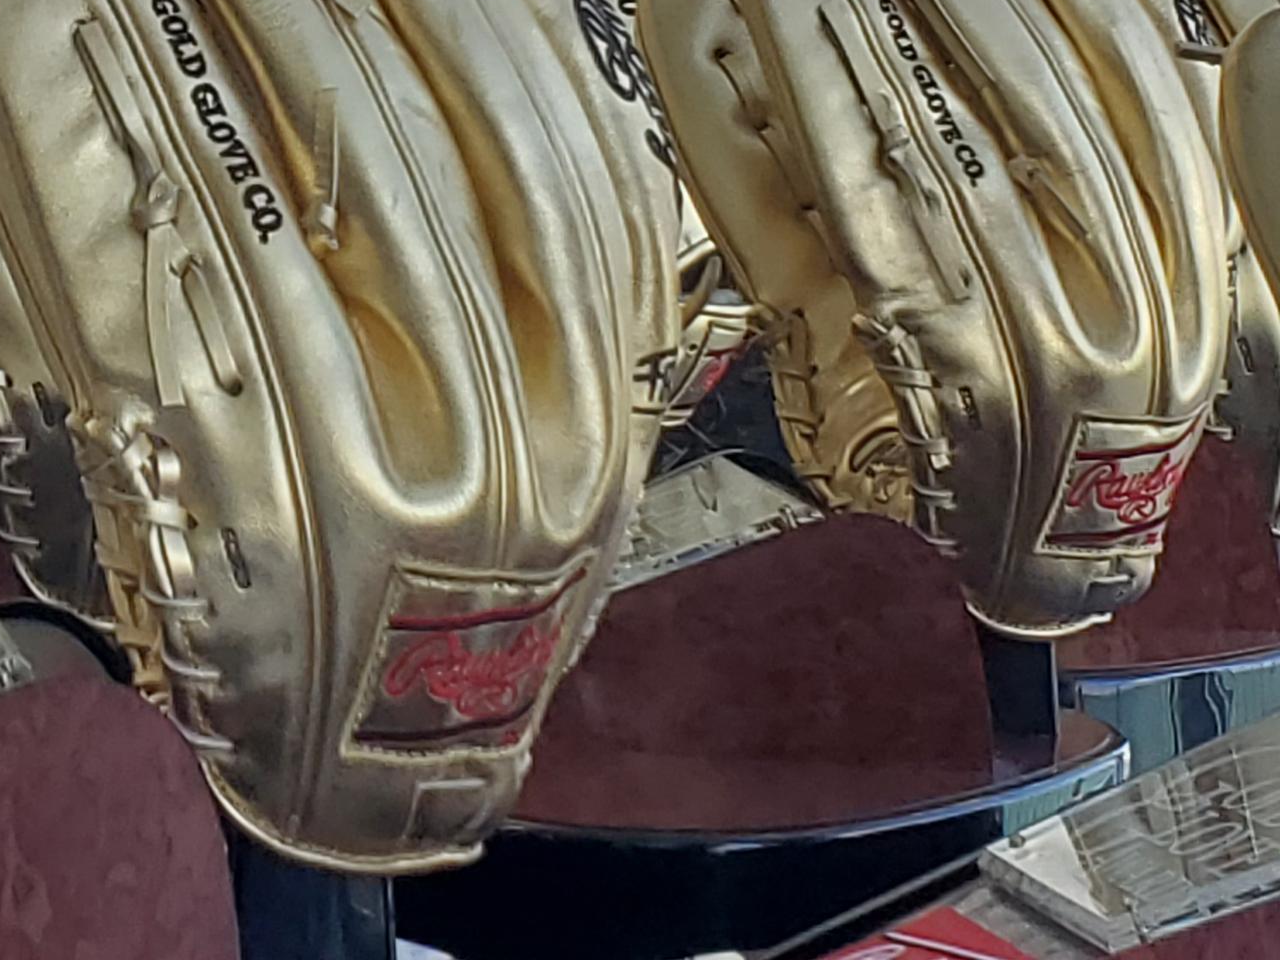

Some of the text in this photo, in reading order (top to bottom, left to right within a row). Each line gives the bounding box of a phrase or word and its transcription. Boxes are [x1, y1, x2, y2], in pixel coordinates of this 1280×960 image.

[190, 82, 261, 185] GLOVE
[242, 184, 284, 245] CO.
[912, 64, 964, 145] GLOVE
[953, 144, 985, 189] CO.
